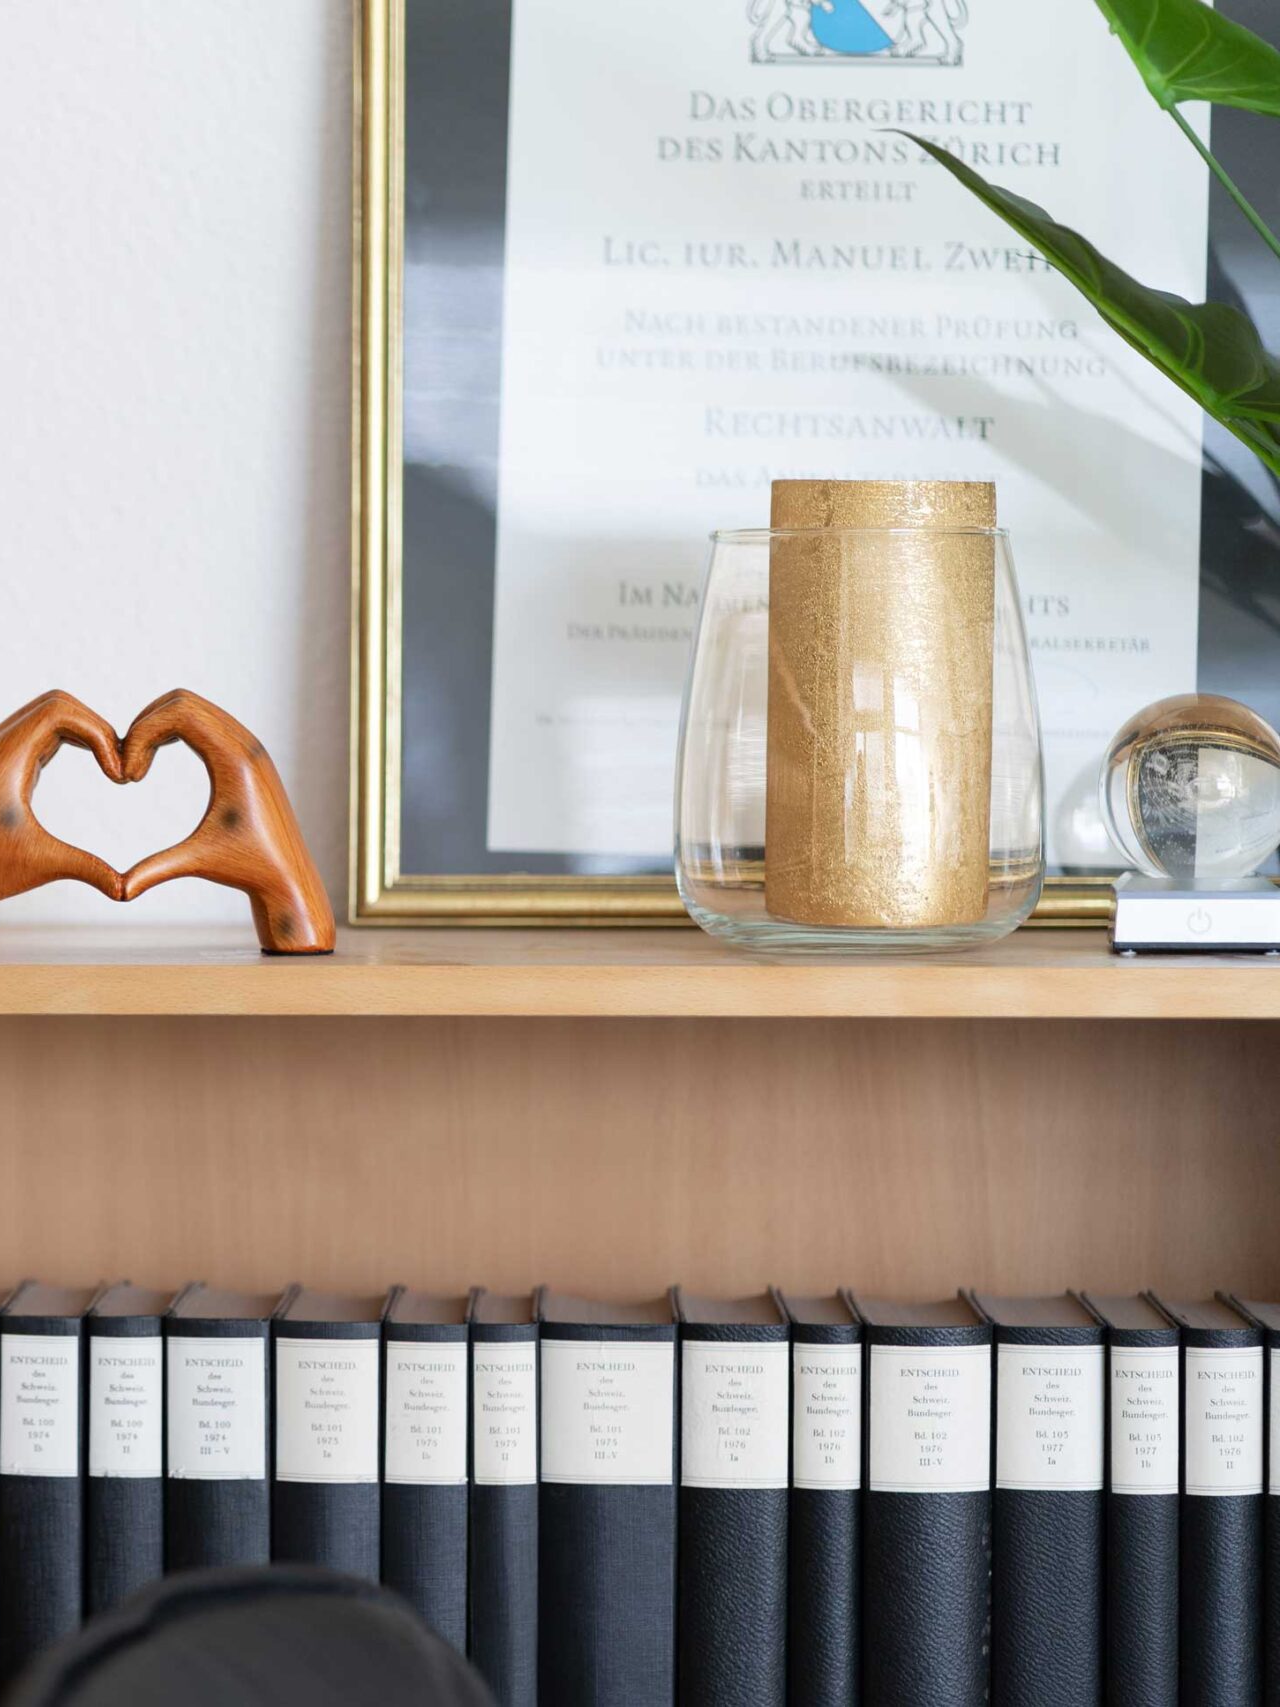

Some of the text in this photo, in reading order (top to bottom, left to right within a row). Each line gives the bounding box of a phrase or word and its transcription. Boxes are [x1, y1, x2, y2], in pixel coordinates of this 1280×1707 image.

[689, 90, 1033, 126] DAS OBERGERICHT
[657, 136, 723, 163] DES
[732, 133, 909, 166] KANTONS
[800, 179, 918, 203] ERTEILT
[771, 241, 926, 272] MANUEL
[944, 241, 1054, 273] ZWEI
[623, 309, 705, 337] NACH
[936, 313, 1079, 342] PRÜFUNG
[704, 348, 762, 373] DER
[704, 407, 996, 440] RECHTSANWALT
[727, 1378, 743, 1387] des
[821, 1380, 838, 1389] des
[922, 1382, 939, 1391] des
[1045, 1381, 1061, 1390] des
[1137, 1384, 1153, 1393] des
[1220, 1384, 1237, 1393] des
[733, 1427, 752, 1436] 102
[828, 1429, 846, 1438] 102
[930, 1431, 948, 1440] 102
[1228, 1434, 1245, 1443] 102
